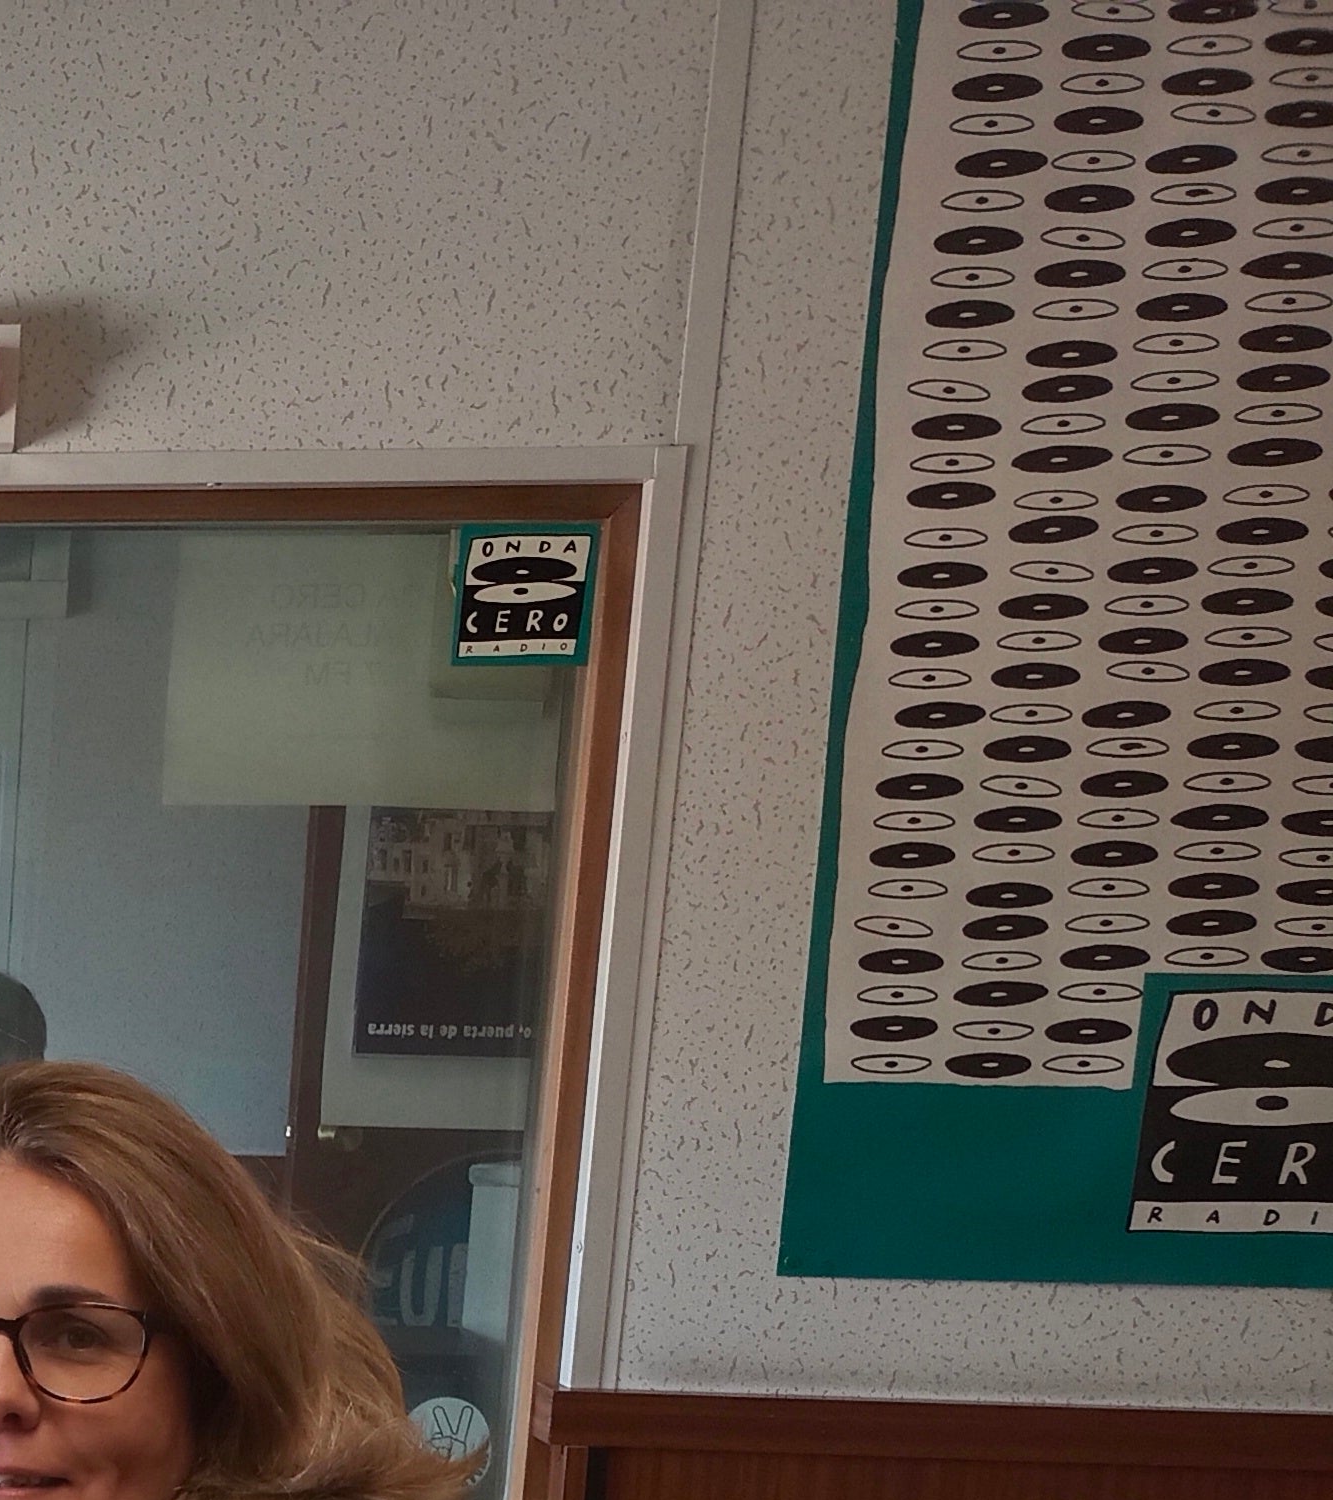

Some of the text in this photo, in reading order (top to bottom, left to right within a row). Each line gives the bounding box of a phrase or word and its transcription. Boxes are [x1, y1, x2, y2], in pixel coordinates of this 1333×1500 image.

[482, 540, 577, 557] ONDA
[465, 609, 568, 633] CERO
[465, 642, 568, 654] RADIO
[367, 1022, 415, 1039] sierra
[419, 1024, 434, 1040] la
[439, 1024, 458, 1040] de
[463, 1023, 515, 1040] puerta
[1151, 1140, 1317, 1185] CER
